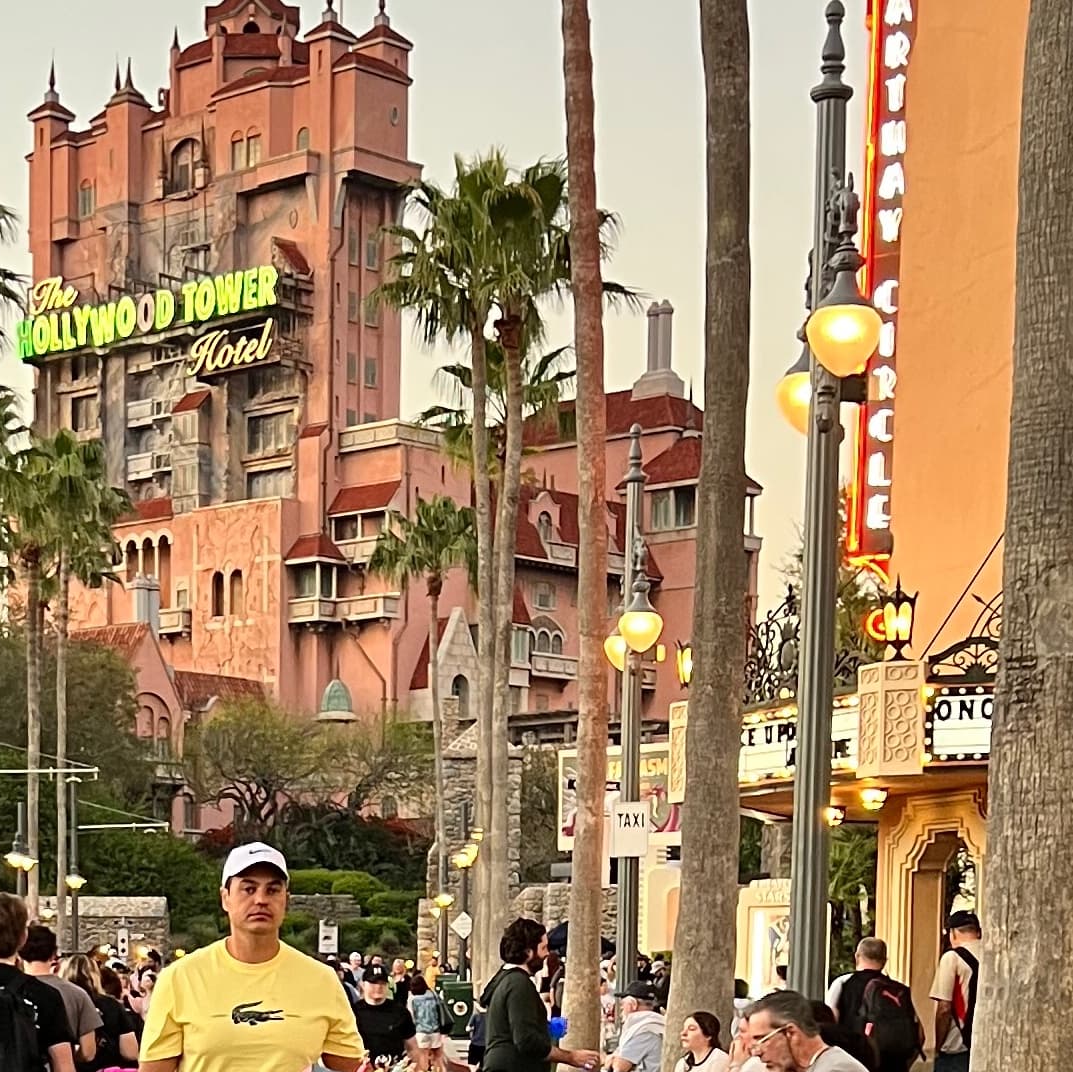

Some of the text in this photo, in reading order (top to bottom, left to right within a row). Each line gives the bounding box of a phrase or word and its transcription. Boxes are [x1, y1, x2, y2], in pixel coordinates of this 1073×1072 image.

[17, 265, 278, 360] HOLLYWOOD TOWER
[29, 275, 78, 316] The
[186, 317, 274, 376] Hotel
[866, 279, 900, 529] CIRCLE
[617, 813, 645, 828] TAXI
